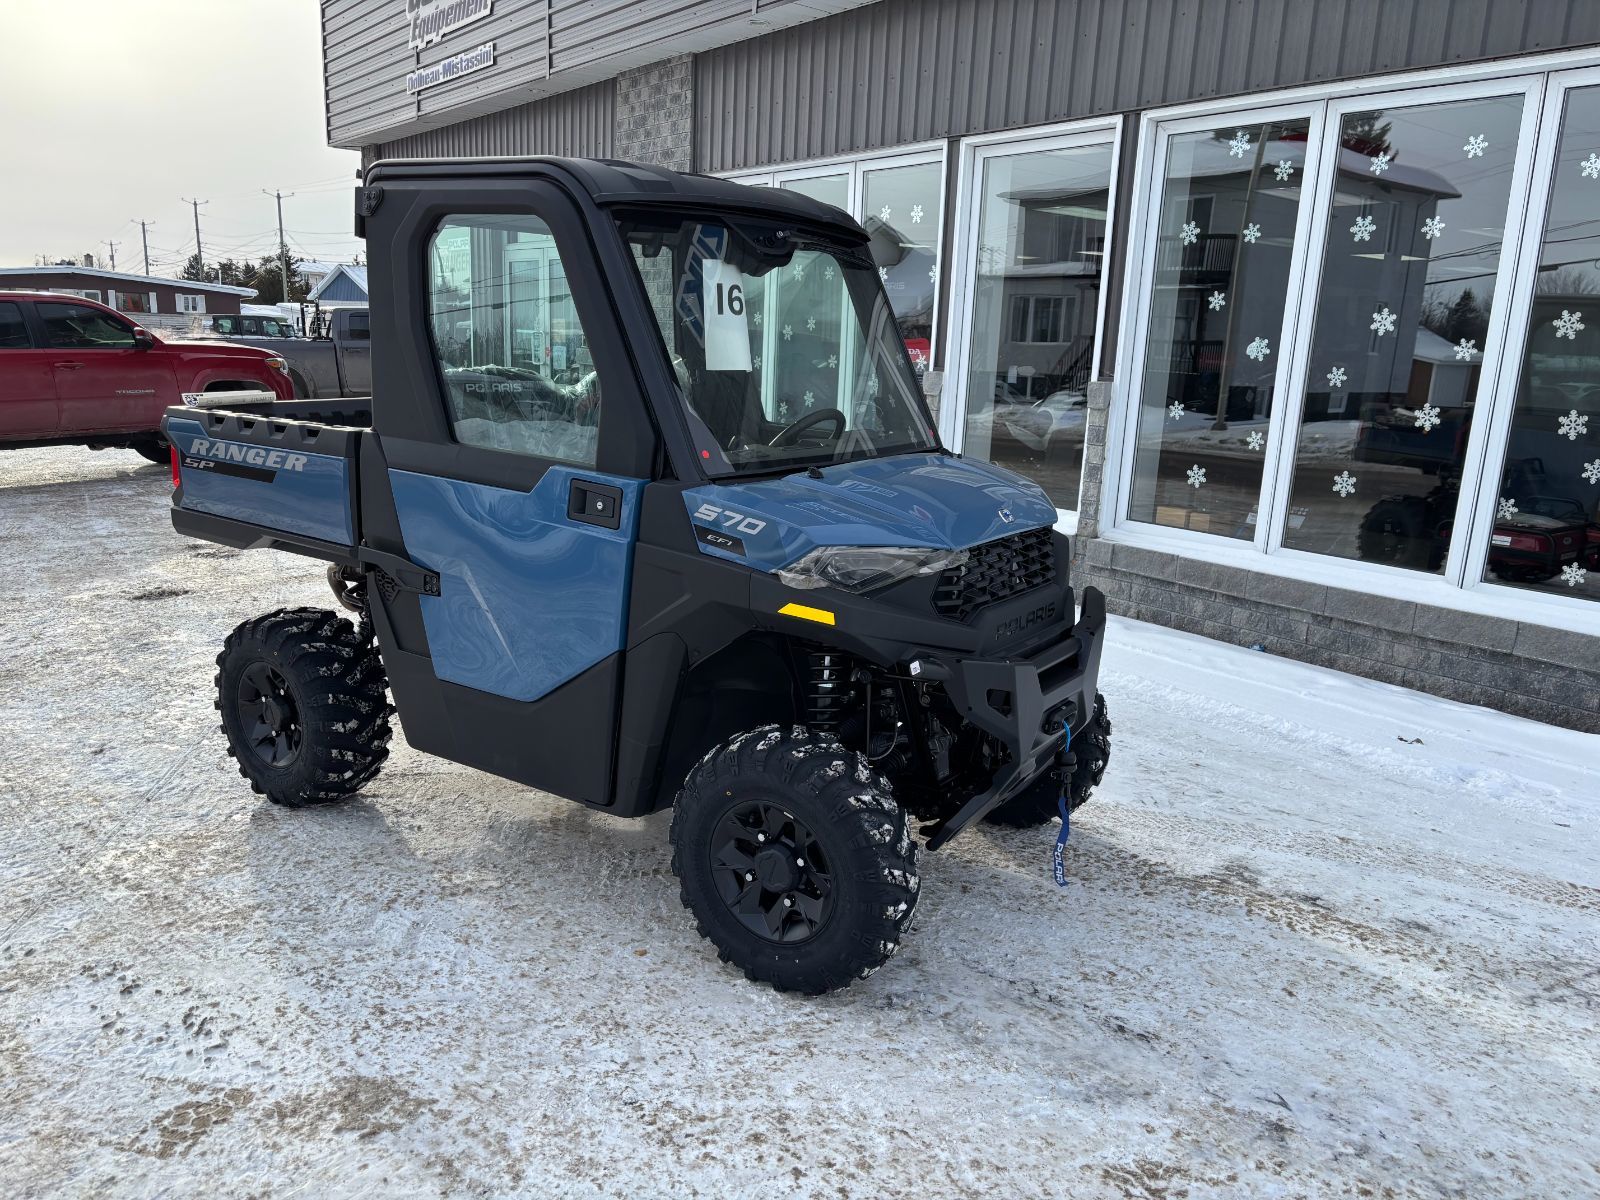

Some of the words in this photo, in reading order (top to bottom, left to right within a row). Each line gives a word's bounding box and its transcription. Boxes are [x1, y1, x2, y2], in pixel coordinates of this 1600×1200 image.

[407, 45, 492, 91] Dolbeau-Mistassini
[716, 283, 744, 316] 16
[184, 457, 216, 469] SP
[190, 438, 308, 472] RANGER
[693, 503, 767, 536] 570
[995, 602, 1056, 641] POLARIS
